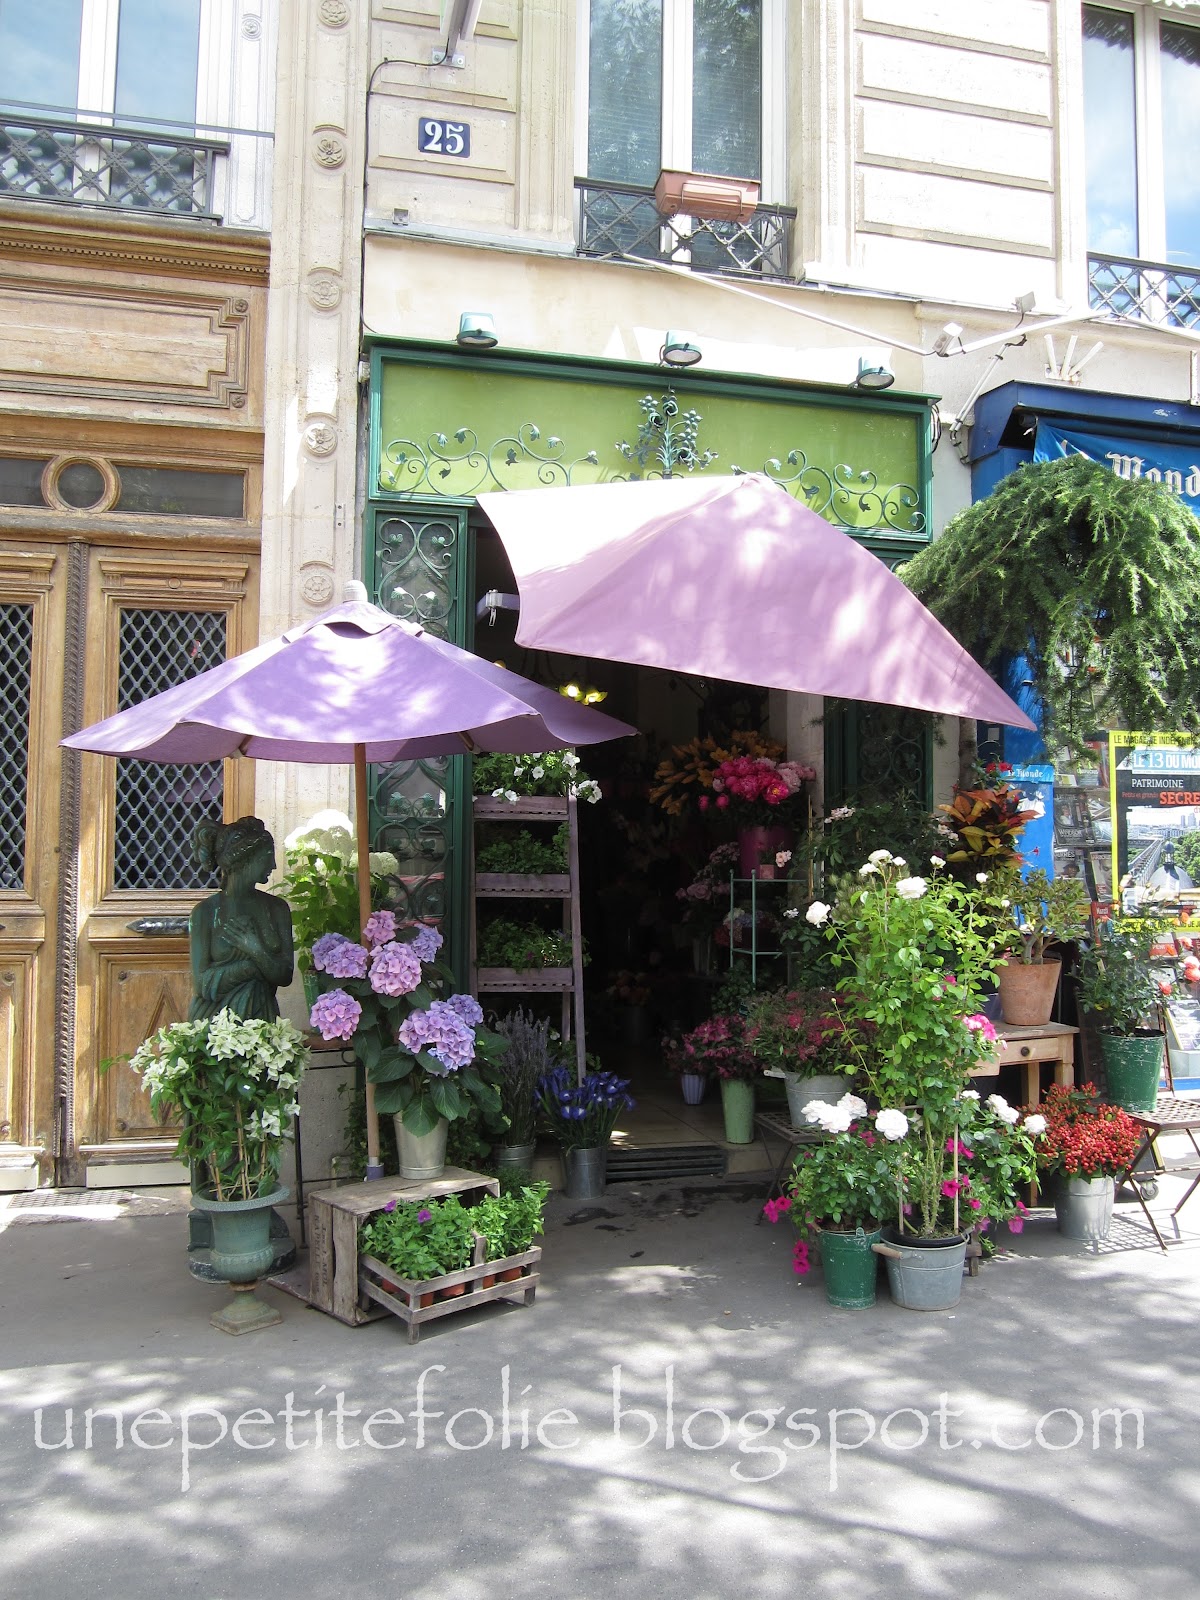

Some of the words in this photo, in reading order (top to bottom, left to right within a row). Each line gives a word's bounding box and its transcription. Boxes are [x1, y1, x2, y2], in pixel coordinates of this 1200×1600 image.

[424, 121, 464, 154] 25
[1114, 734, 1121, 744] LE
[1133, 752, 1146, 768] LE
[1149, 752, 1164, 769] 13
[1166, 754, 1180, 769] DU
[1016, 768, 1043, 778] Monde
[1131, 778, 1184, 788] PATRIMOINE
